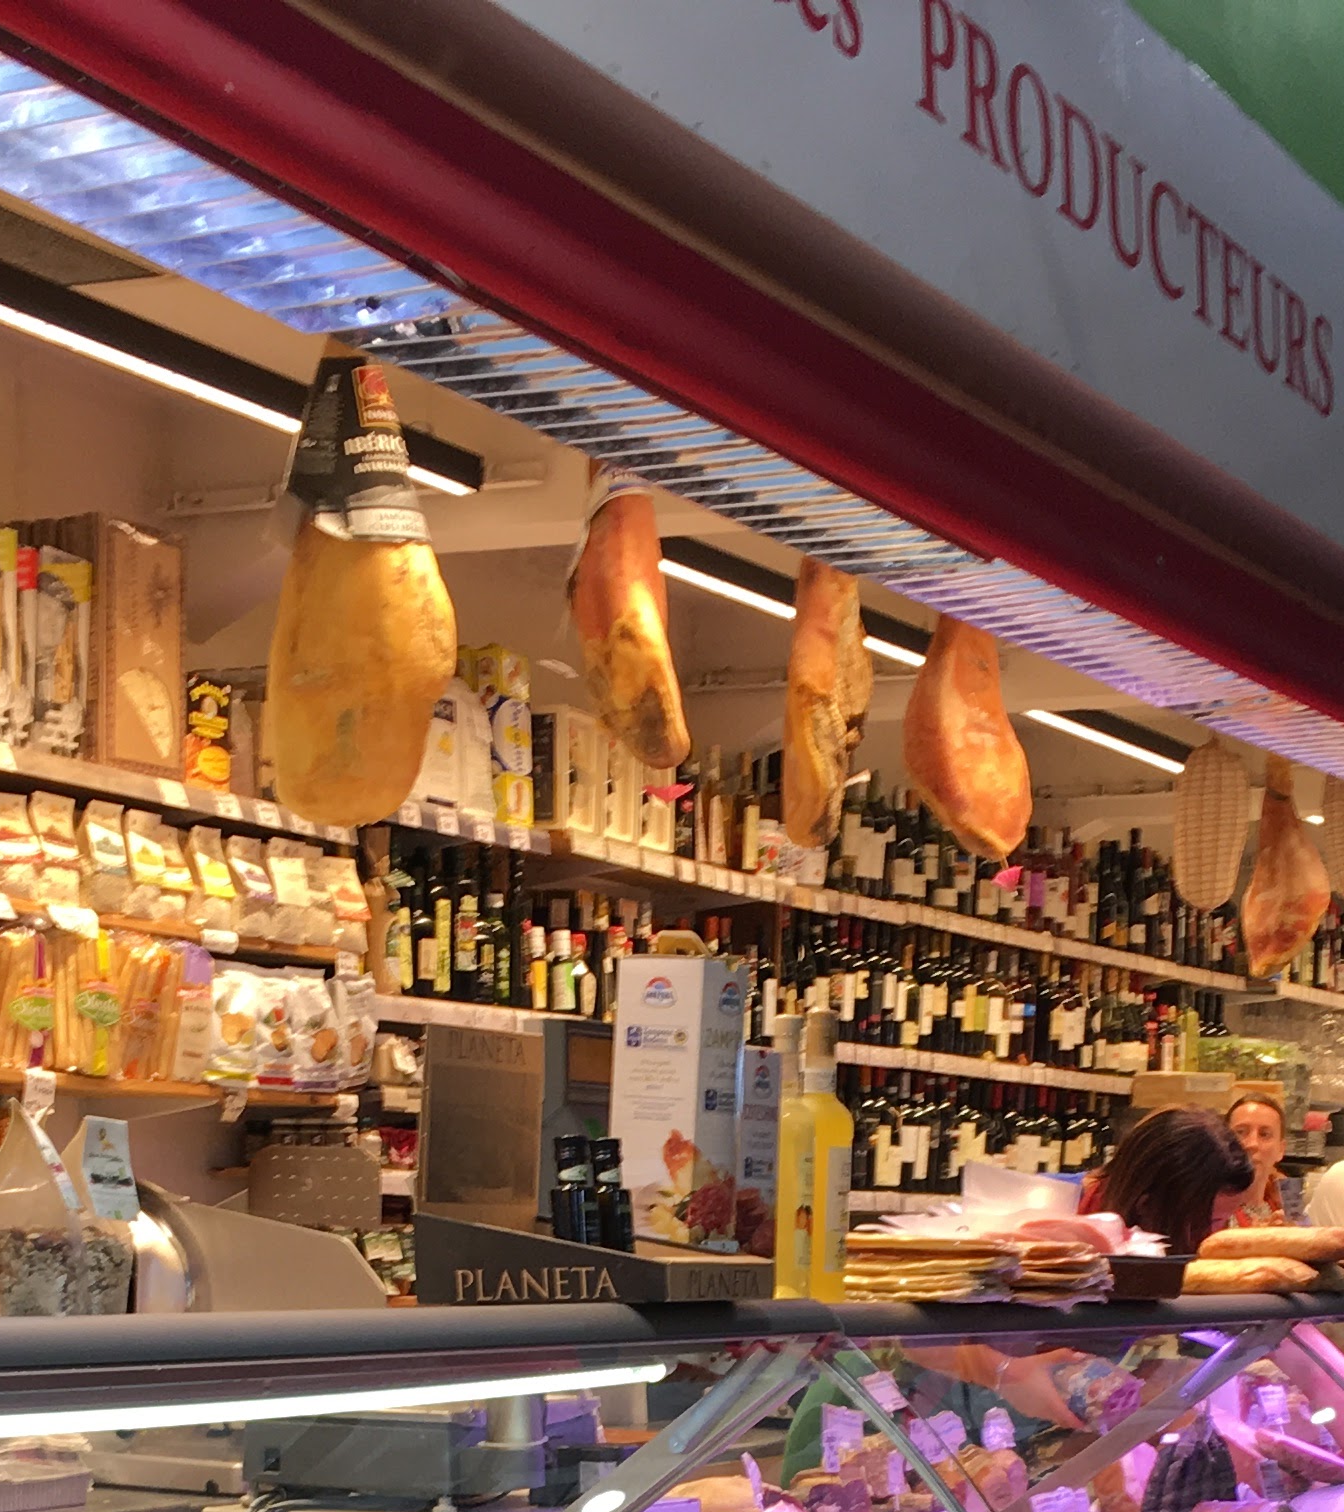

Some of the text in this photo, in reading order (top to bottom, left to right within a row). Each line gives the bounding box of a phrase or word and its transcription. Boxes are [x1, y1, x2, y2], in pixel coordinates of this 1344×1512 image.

[915, 0, 1333, 418] PRODUCTEURS
[449, 1030, 527, 1066] PLANETA
[457, 1267, 620, 1301] PLANETA
